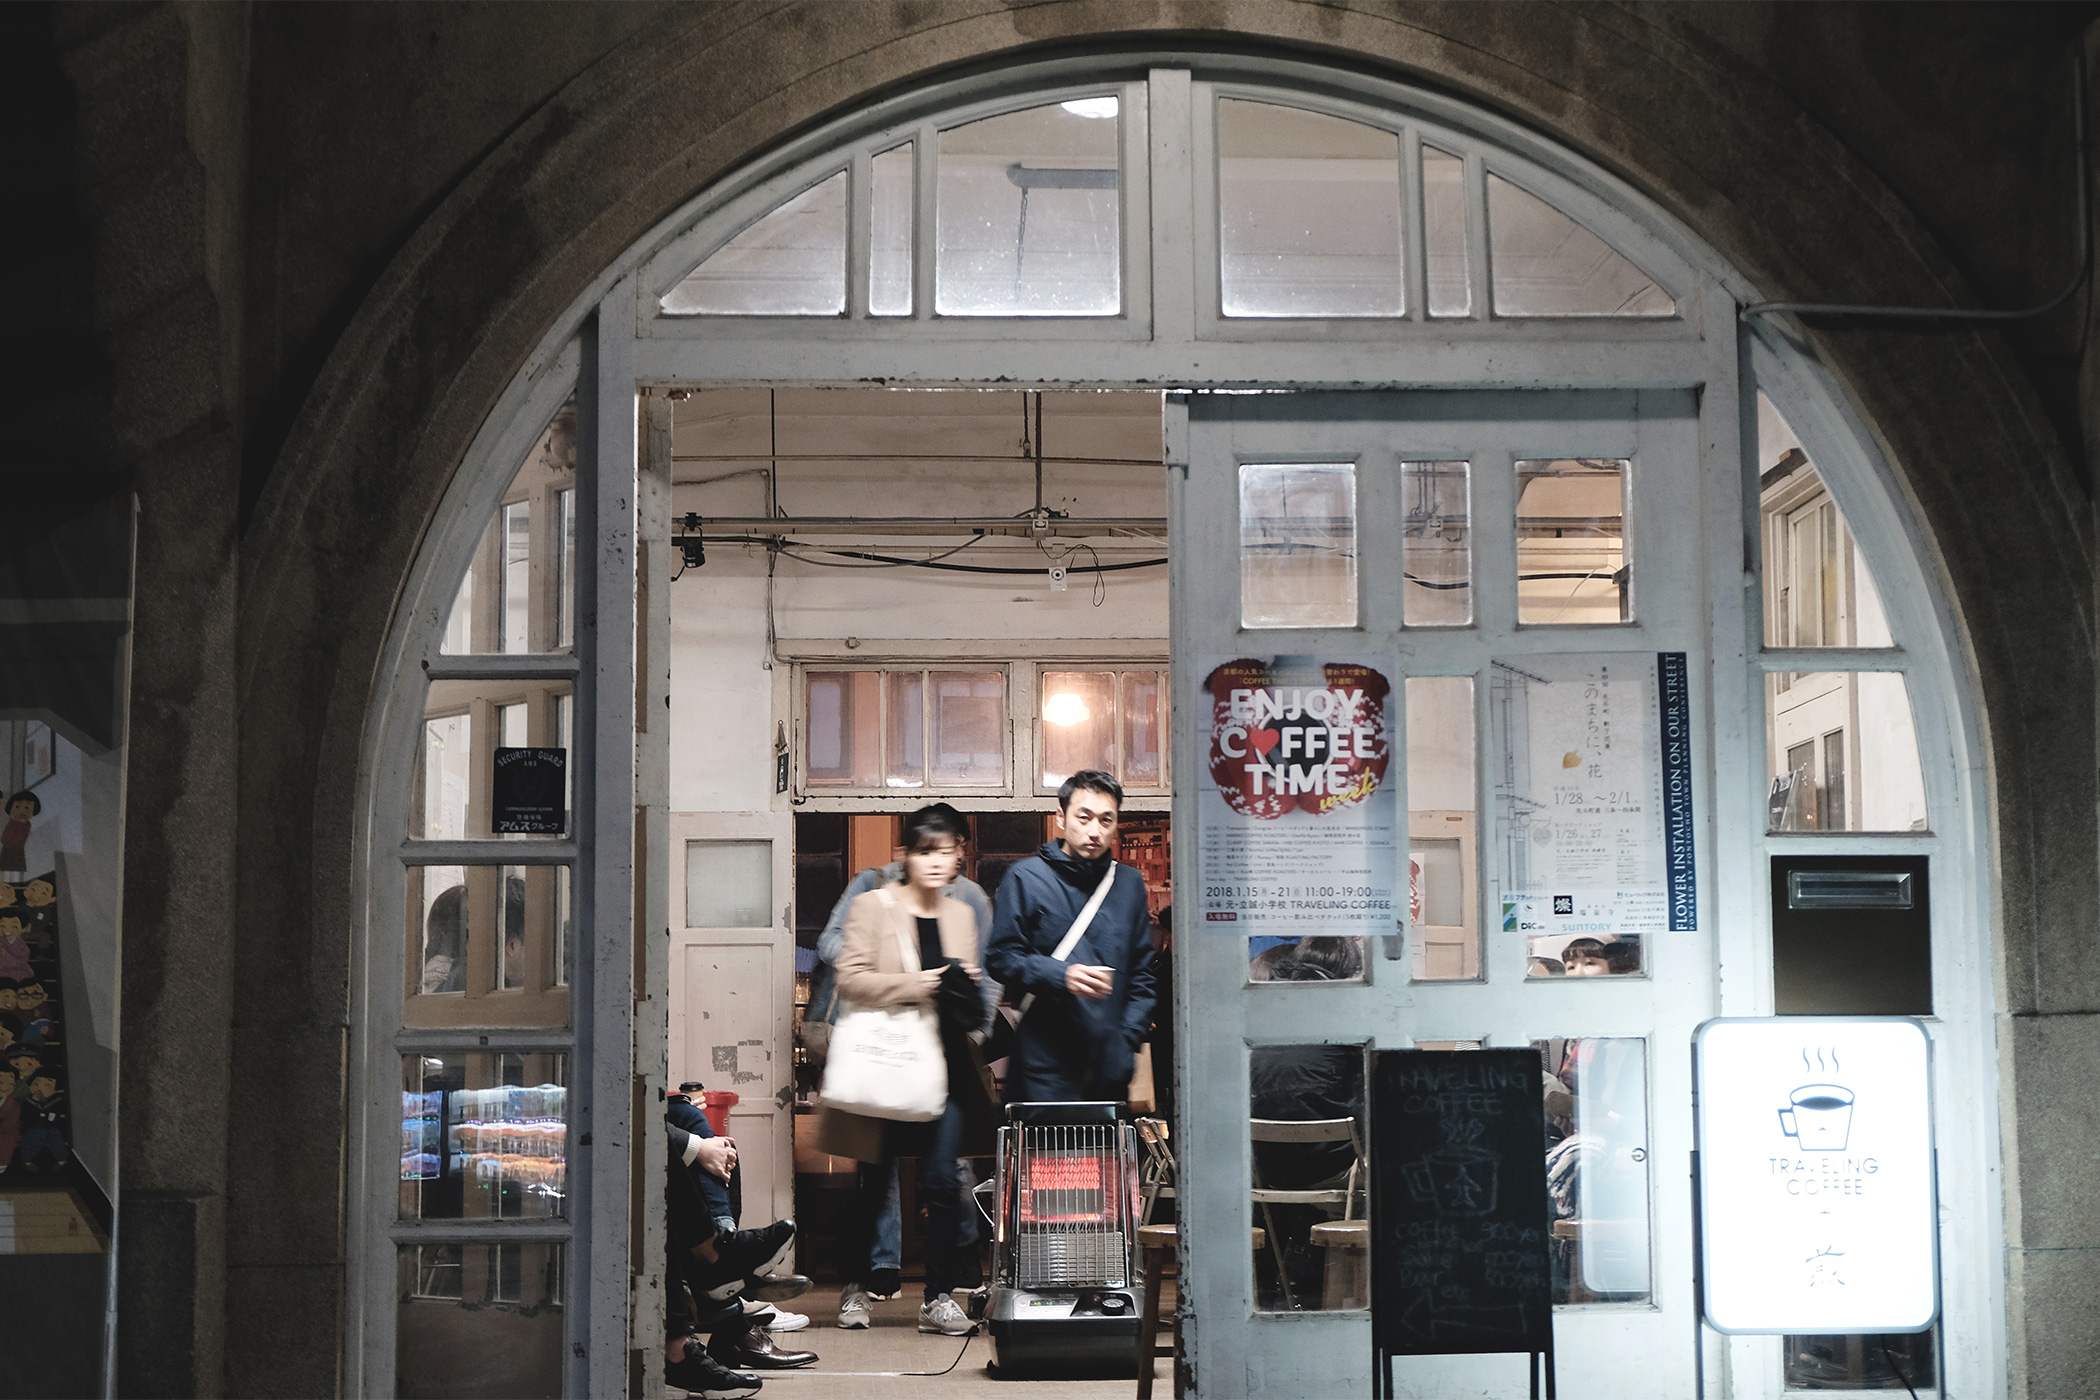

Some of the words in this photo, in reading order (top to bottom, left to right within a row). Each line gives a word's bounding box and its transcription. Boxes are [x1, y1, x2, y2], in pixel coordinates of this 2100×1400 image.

[1665, 654, 1679, 702] STREET
[1679, 658, 1687, 719] CONFERENCE
[1230, 688, 1364, 721] ENJOY
[1668, 705, 1680, 738] OUR
[497, 750, 532, 767] SECURITY
[537, 750, 564, 768] GUARD
[1669, 741, 1681, 765] ON
[1682, 724, 1690, 774] PLANNING
[1244, 763, 1350, 796] TIME
[1319, 766, 1375, 810] week
[1683, 779, 1691, 806] TOWN
[1555, 792, 1584, 806] 1/28
[1609, 791, 1630, 805] 2/1
[1670, 768, 1686, 870] INSTALLATION
[1684, 811, 1693, 865] PONTOCHO
[1206, 886, 1259, 897] 2018.1.15
[1688, 870, 1694, 881] BY
[1290, 900, 1348, 910] TRAVELING
[1351, 900, 1391, 910] COFFEE
[1674, 873, 1688, 930] FLOWER
[1688, 885, 1696, 930] POWERED
[1562, 922, 1612, 932] SUNTORY
[1786, 1179, 1862, 1195] COFFEE
